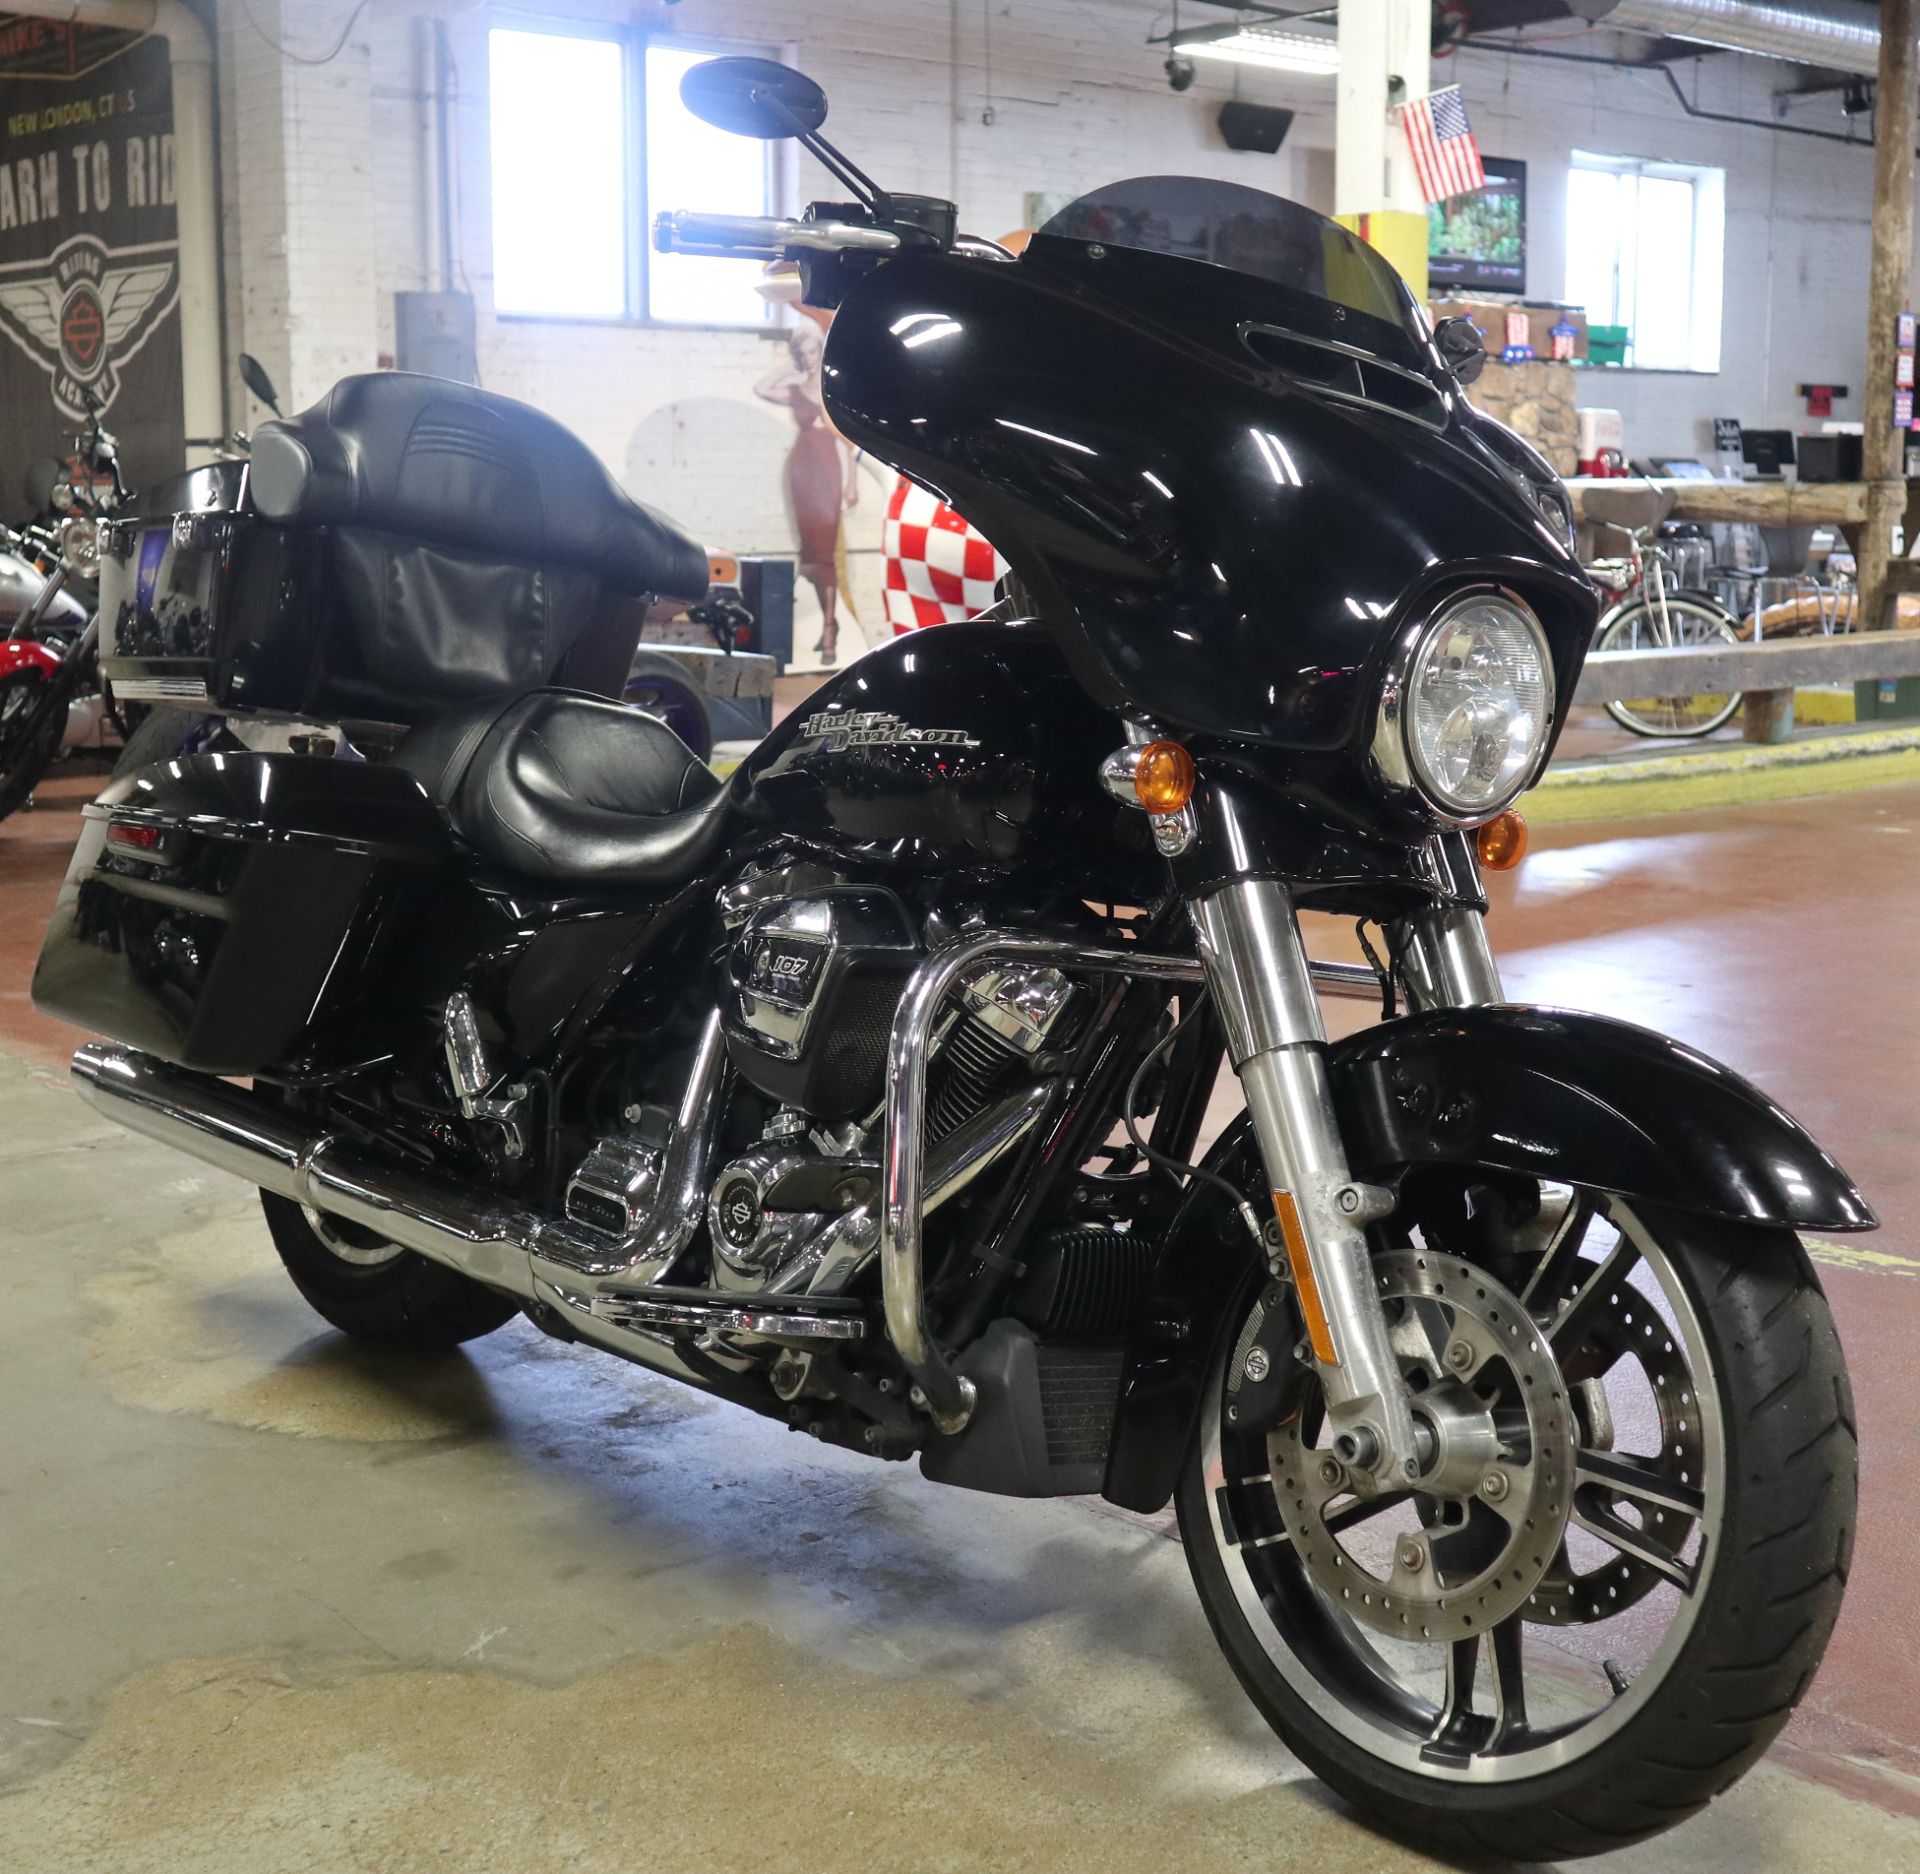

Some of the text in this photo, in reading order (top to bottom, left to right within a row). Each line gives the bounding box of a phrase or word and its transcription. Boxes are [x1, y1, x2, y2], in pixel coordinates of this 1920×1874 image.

[8, 112, 38, 137] NEW
[73, 140, 110, 213] TO
[799, 708, 900, 737] Harley
[823, 722, 980, 752] Davidson
[773, 955, 809, 975] 107
